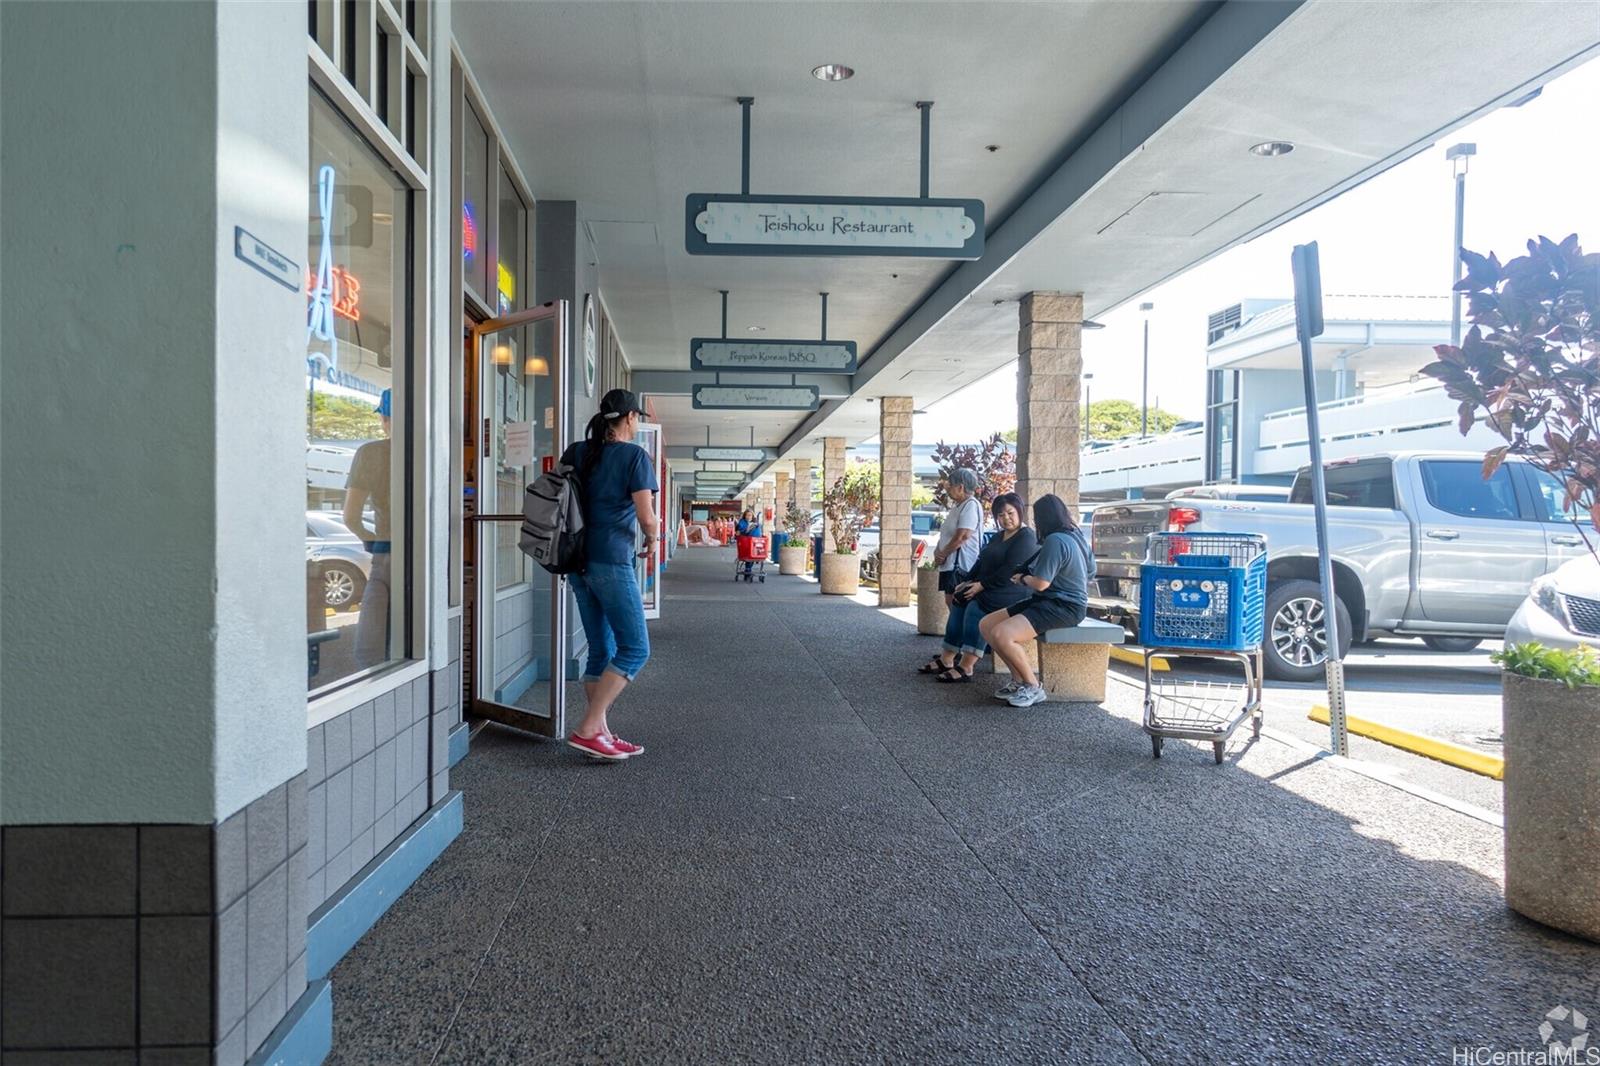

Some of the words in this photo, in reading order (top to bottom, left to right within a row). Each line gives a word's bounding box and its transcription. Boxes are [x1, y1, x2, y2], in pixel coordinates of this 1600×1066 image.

[758, 214, 825, 233] Teishoku
[831, 216, 915, 235] Restaurant
[758, 351, 787, 363] Korean
[788, 351, 817, 364] BBQ
